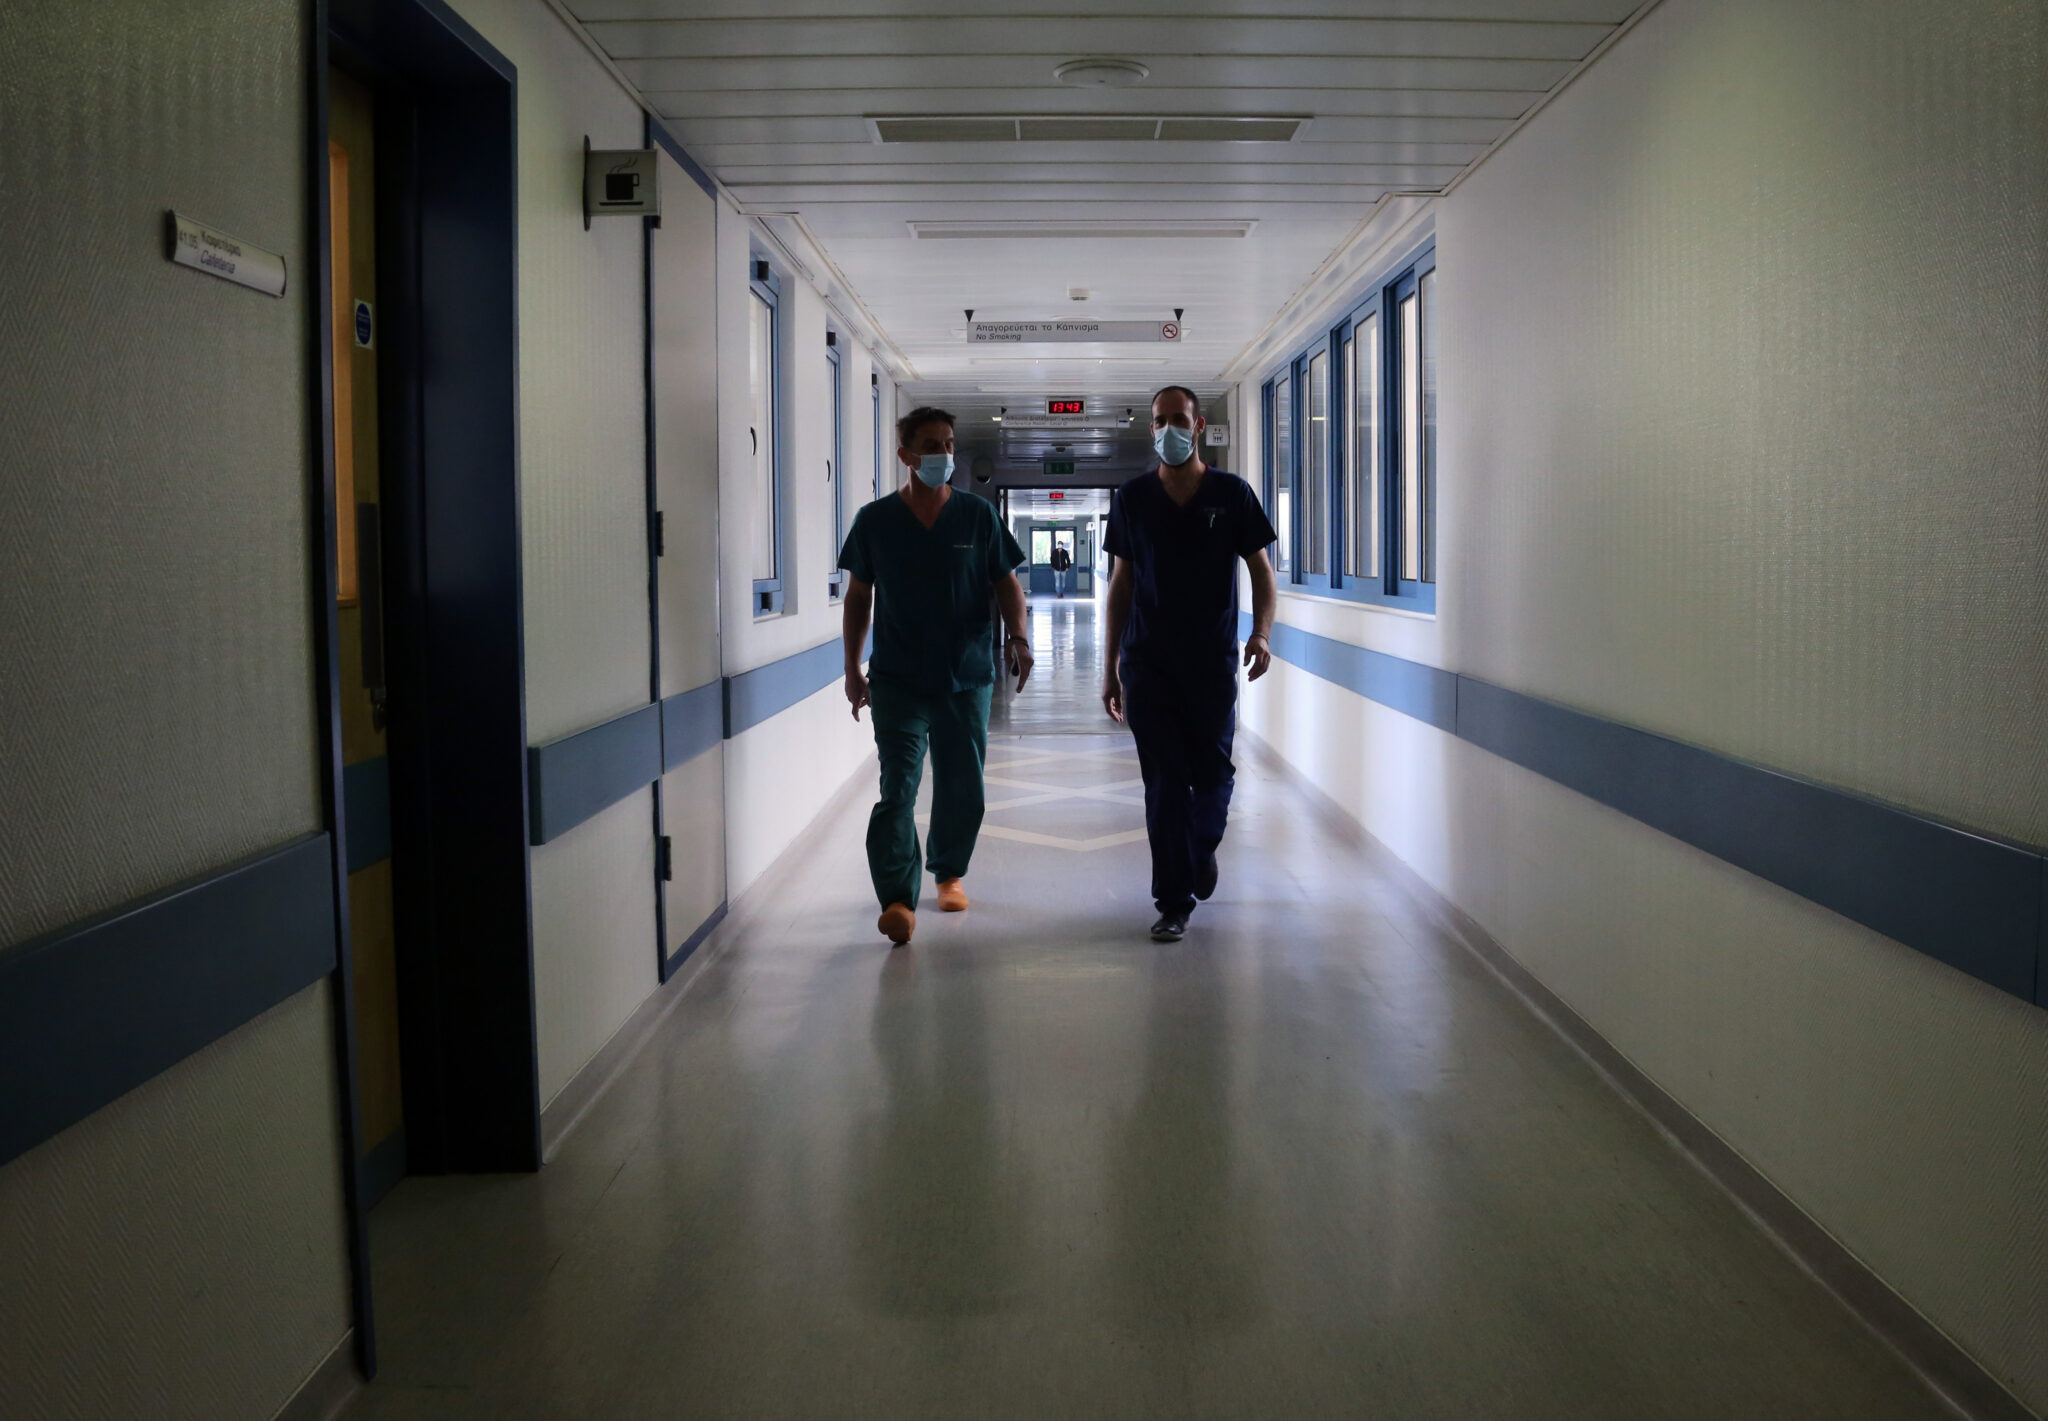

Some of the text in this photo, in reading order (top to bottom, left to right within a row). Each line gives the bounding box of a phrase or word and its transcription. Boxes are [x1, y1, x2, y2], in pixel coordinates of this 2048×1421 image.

[976, 322, 1099, 333] Απαγορεύεται το Κάπνισμα
[989, 333, 1022, 342] Smoking
